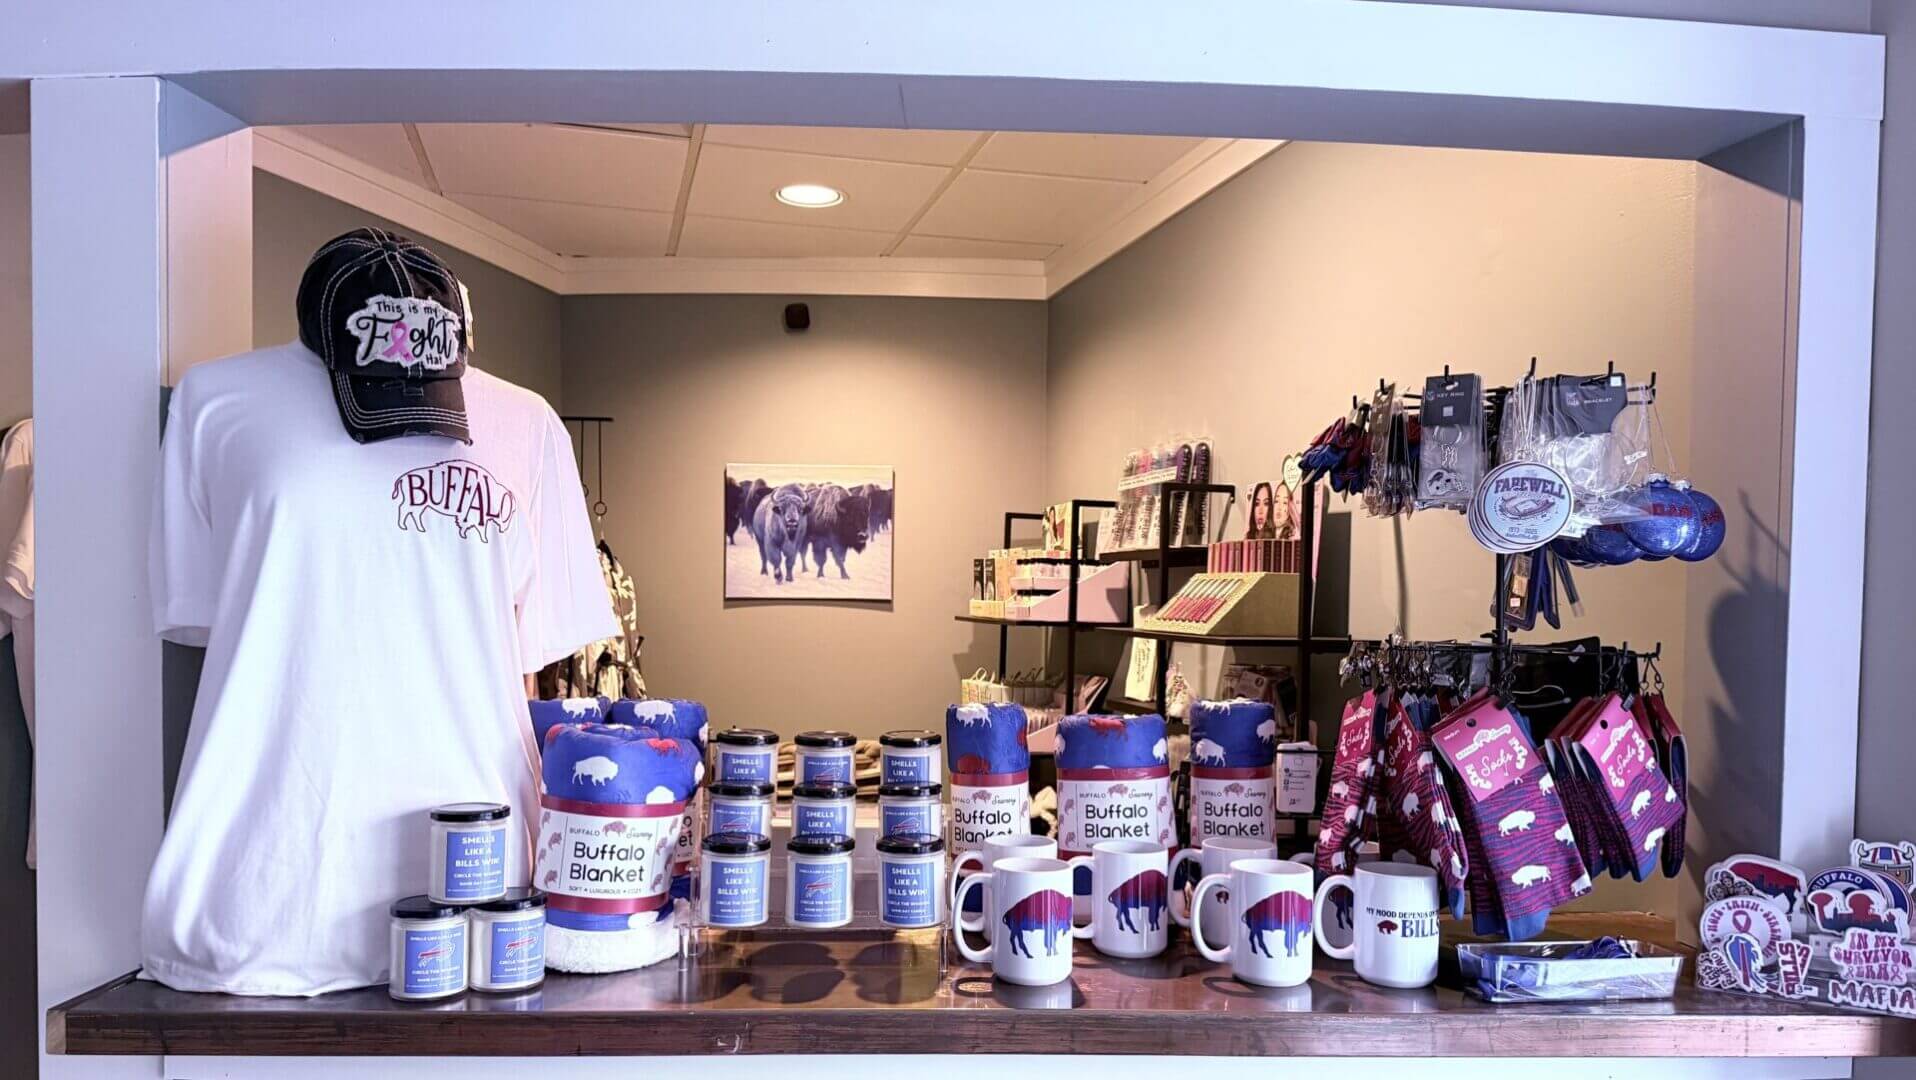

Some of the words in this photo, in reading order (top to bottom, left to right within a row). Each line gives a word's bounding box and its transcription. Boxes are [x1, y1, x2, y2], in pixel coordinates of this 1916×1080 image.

[375, 301, 402, 313] This
[408, 303, 419, 314] is
[424, 306, 438, 318] my
[407, 464, 515, 528] BUFFALO
[1494, 476, 1566, 500] FAREWELL
[1480, 748, 1514, 777] Socks
[954, 807, 1012, 825] Buffalo
[1085, 803, 1148, 819] Buffalo
[1204, 801, 1263, 818] Buffalo
[569, 827, 601, 837] BUFFALO
[1084, 821, 1150, 838] Blanket
[1203, 819, 1265, 836] Blanket
[462, 835, 496, 845] SMELLS
[464, 848, 483, 856] LIKE
[573, 841, 646, 861] Buffalo
[455, 859, 480, 867] BILLS
[891, 867, 921, 875] SMELLS
[569, 863, 645, 882] Blanket
[1812, 871, 1863, 890] BUFFALO
[589, 886, 621, 894] LUXURIOUS
[894, 878, 910, 886] LIKE
[1366, 906, 1375, 915] MY
[1376, 908, 1397, 918] MOOD
[1398, 910, 1428, 919] DEPENDS
[1849, 932, 1869, 949] IN
[1874, 935, 1897, 948] MY
[1833, 947, 1912, 968] SURVIVOR
[1831, 981, 1916, 1010] MAFIA
